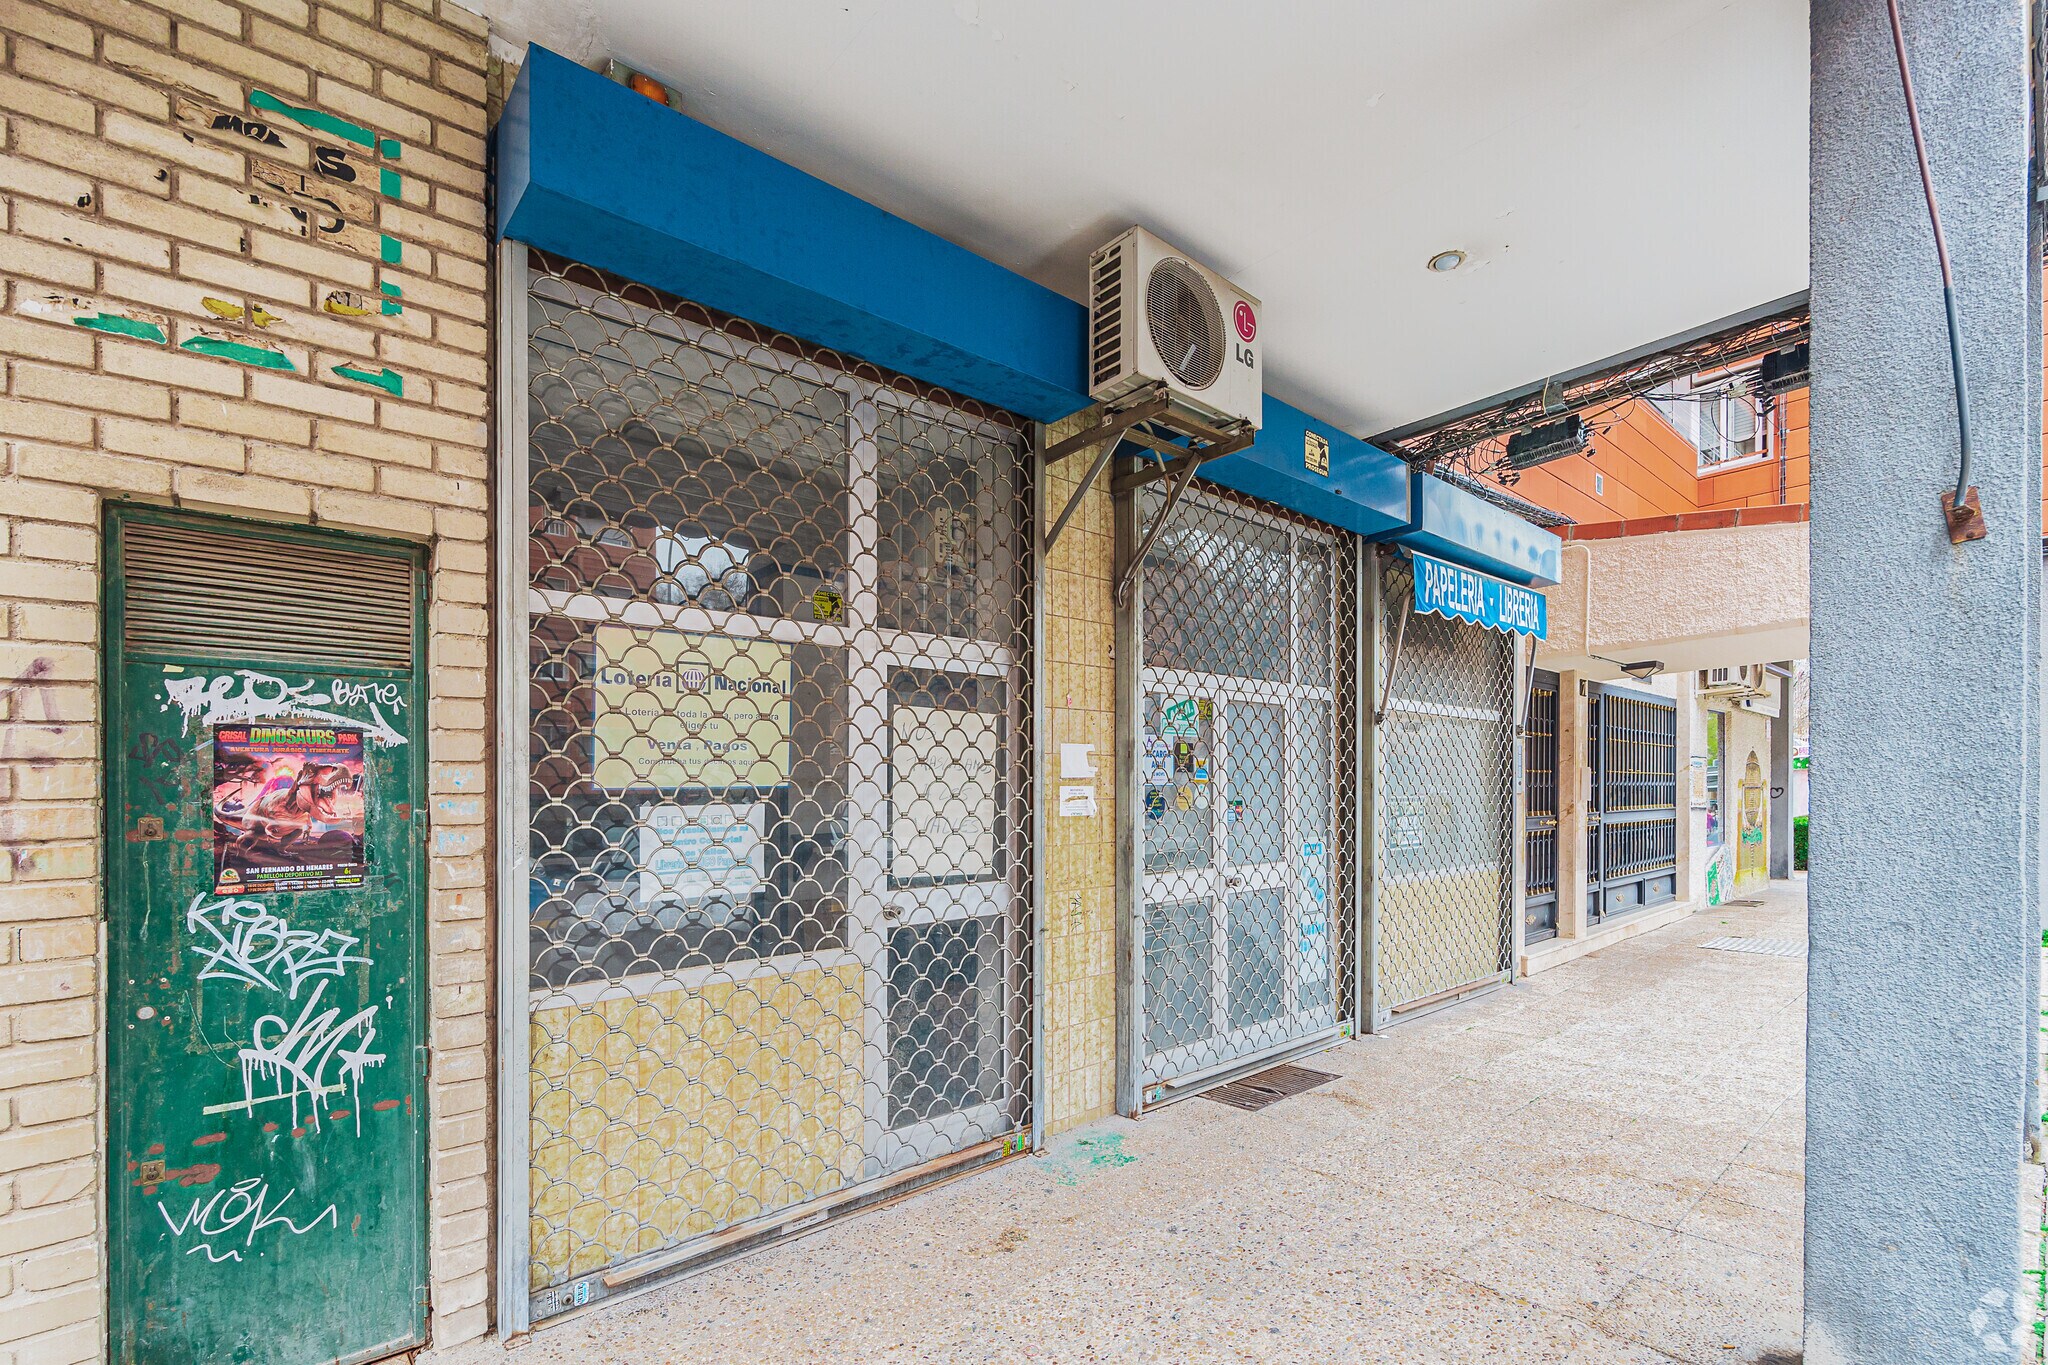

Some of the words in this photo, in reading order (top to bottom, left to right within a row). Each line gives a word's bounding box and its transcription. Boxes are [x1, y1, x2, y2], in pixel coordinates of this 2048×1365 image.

[1236, 342, 1254, 369] LG
[1425, 561, 1486, 617] PAPELERIA
[1499, 584, 1540, 631] LIBRERIA
[714, 675, 787, 694] Nacional
[700, 711, 708, 719] la
[734, 713, 753, 722] pero
[755, 713, 779, 721] ara
[710, 722, 719, 730] tu
[218, 730, 248, 743] CRISAL
[250, 727, 336, 746] DINOSAURS
[337, 733, 359, 744] PARK
[689, 757, 702, 765] tus
[246, 867, 260, 875] SAN
[260, 865, 295, 874] FERNANDO
[306, 863, 334, 871] HENARES
[285, 870, 315, 879] DEPORTIVO
